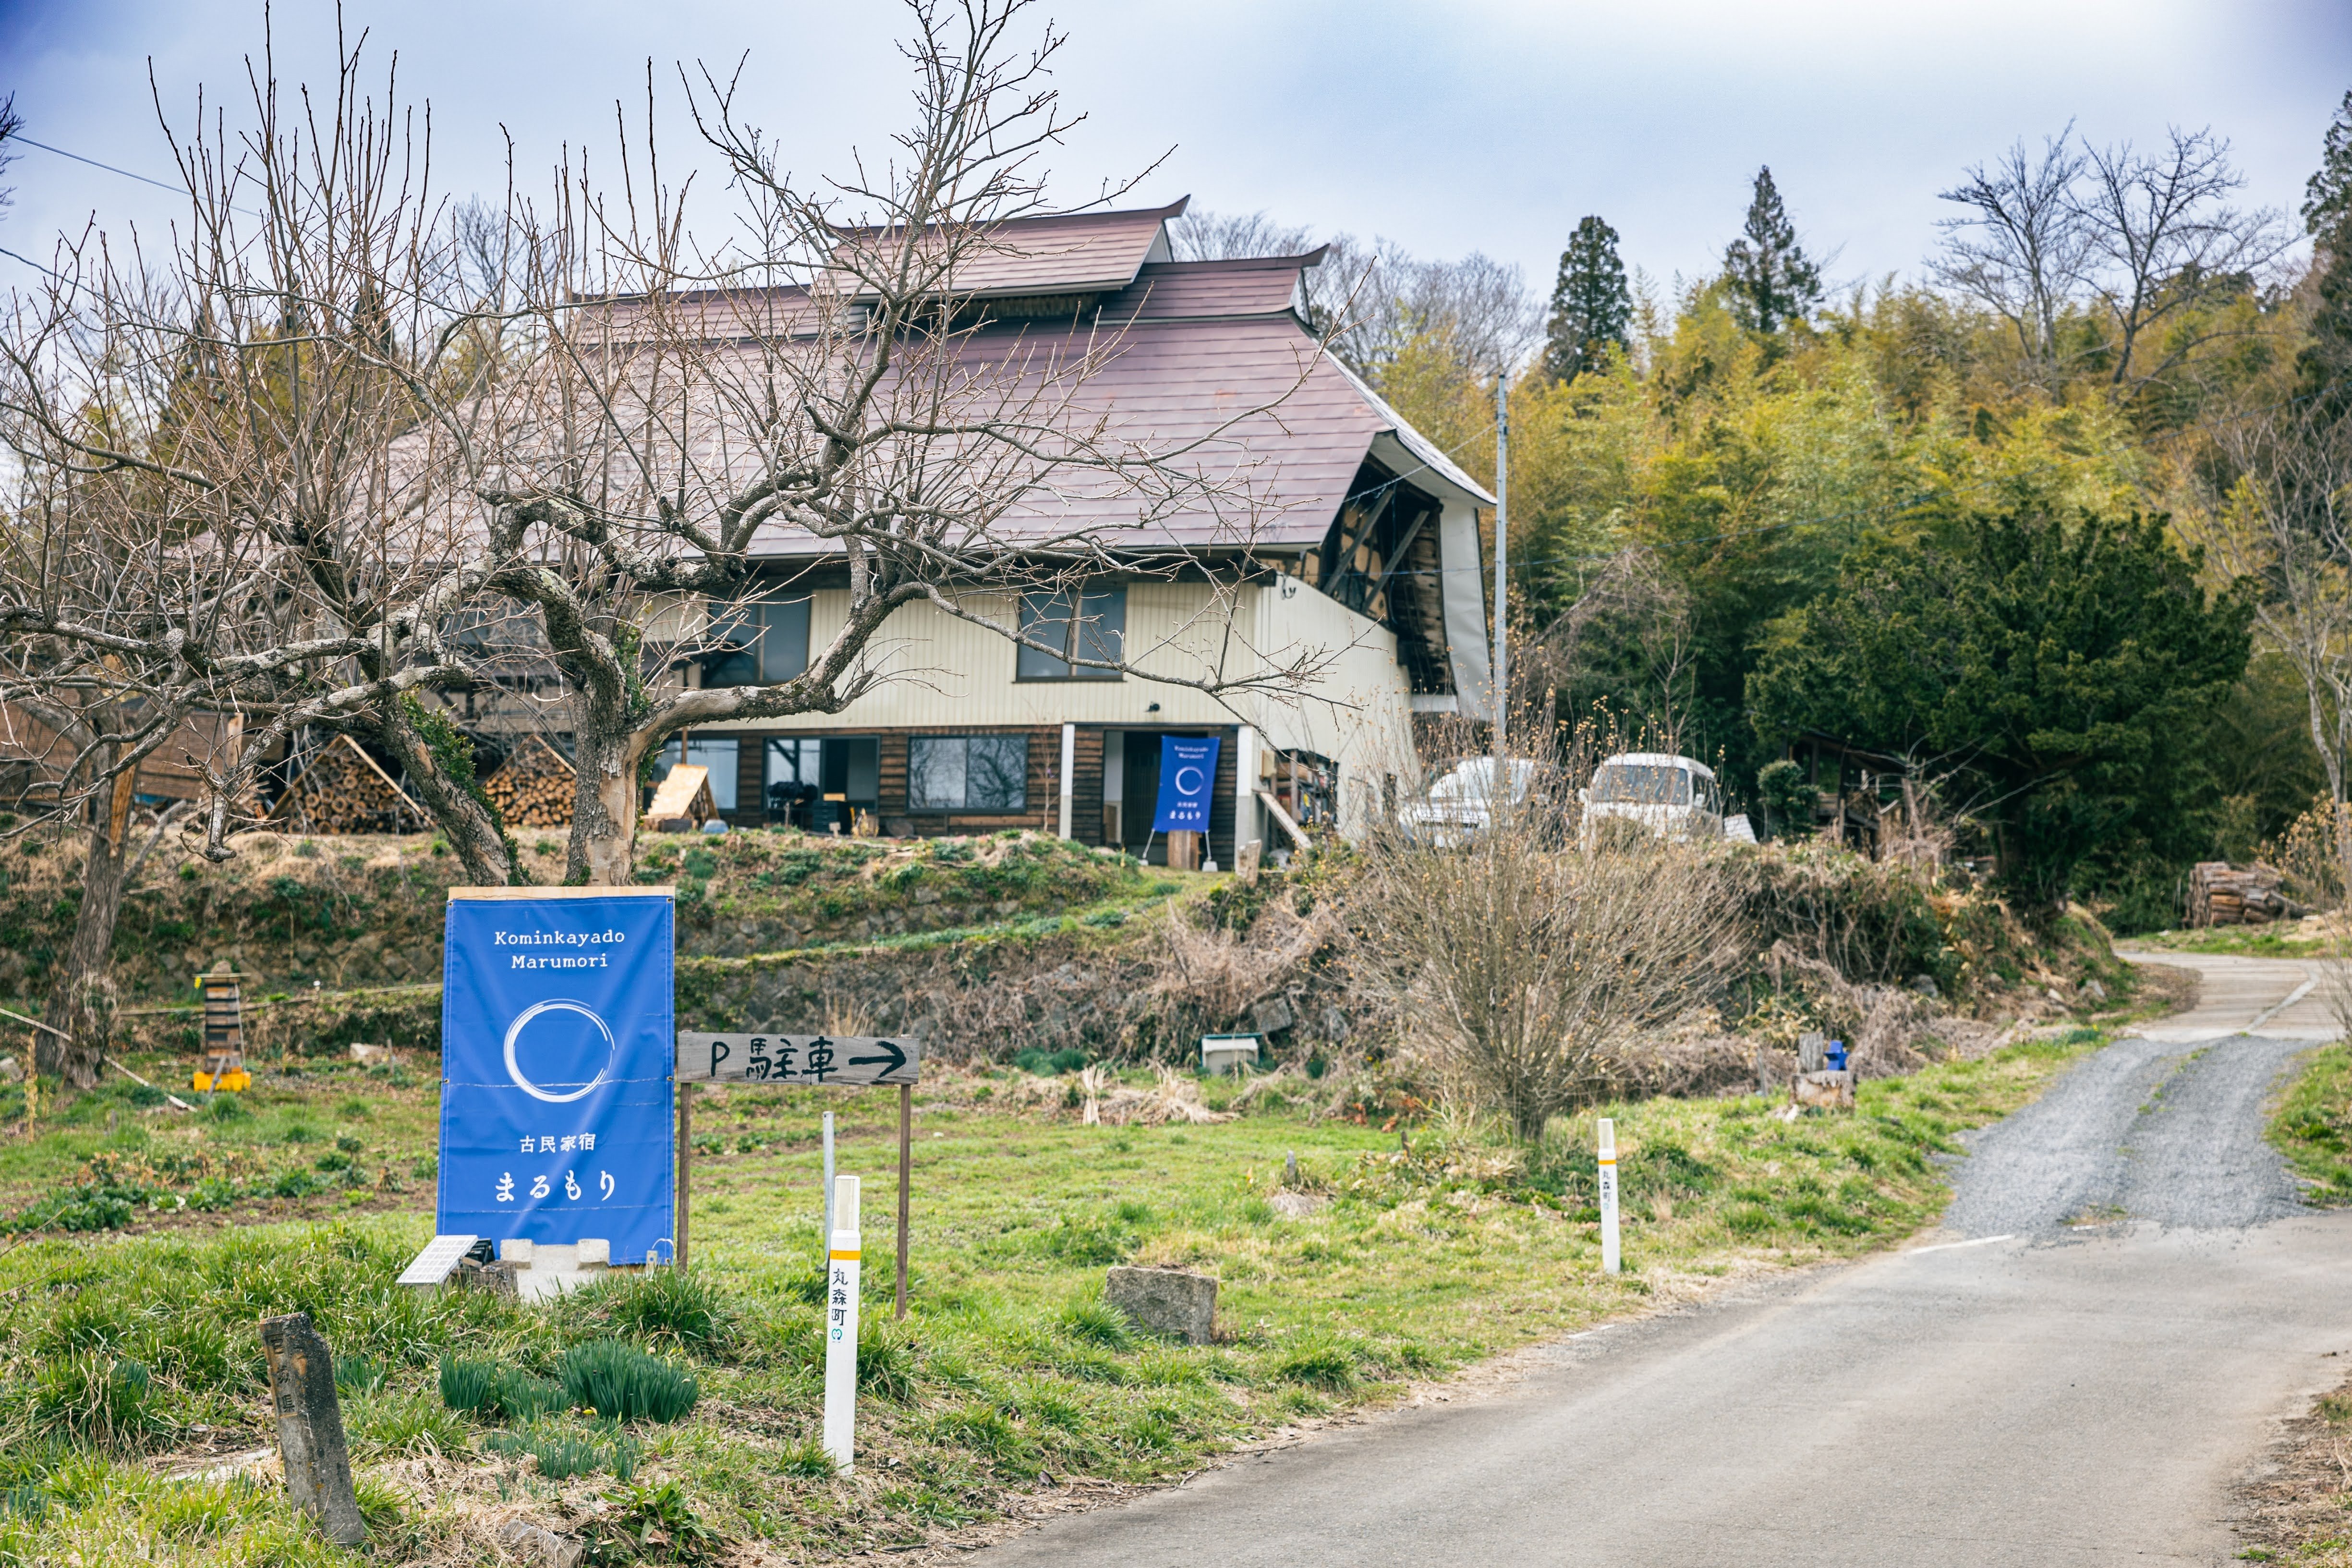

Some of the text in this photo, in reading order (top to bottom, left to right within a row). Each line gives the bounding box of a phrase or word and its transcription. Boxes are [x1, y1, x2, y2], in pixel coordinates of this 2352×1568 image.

[495, 930, 625, 947] Kominkayado
[511, 953, 608, 969] Marumori
[710, 1036, 838, 1082] P 駐車
[520, 1132, 596, 1154] 古民家宿
[495, 1169, 615, 1202] まるもり
[832, 1268, 849, 1326] 丸森町
